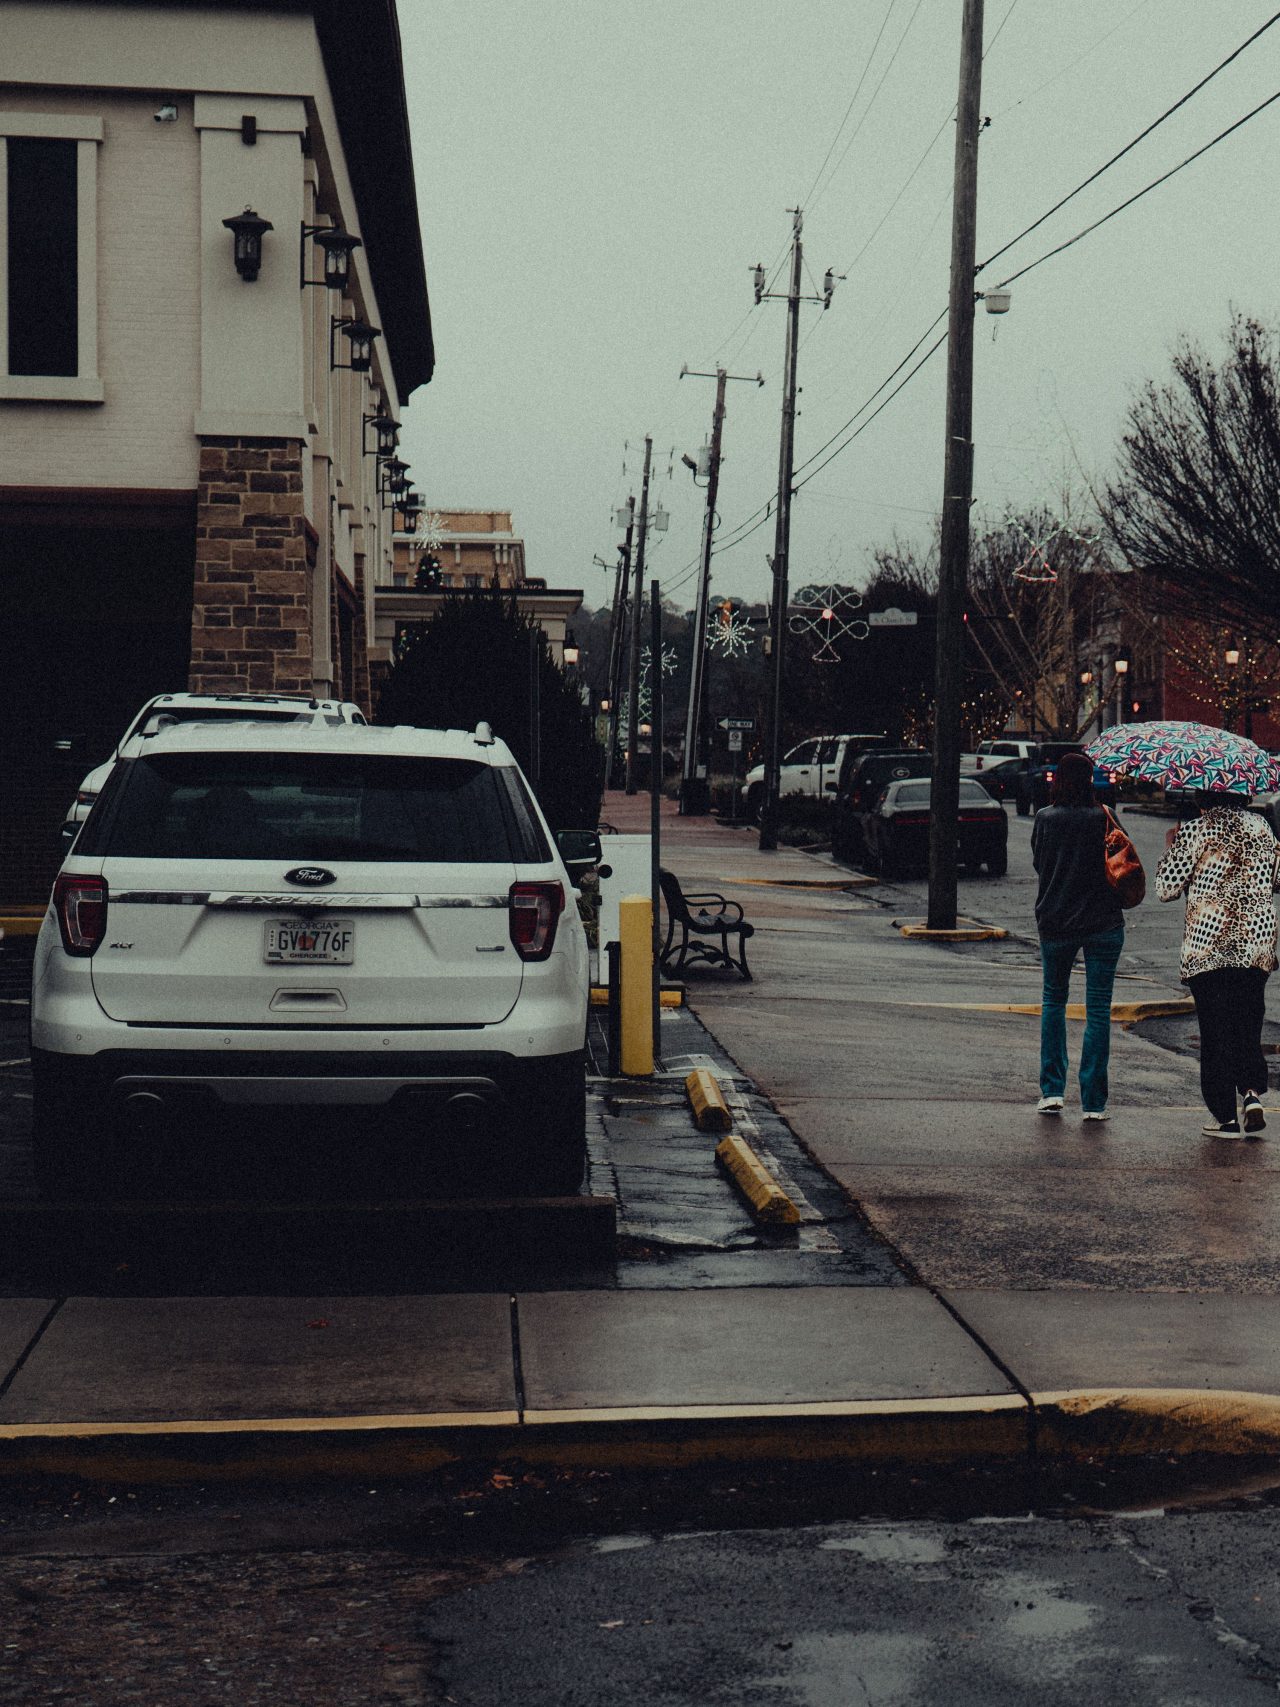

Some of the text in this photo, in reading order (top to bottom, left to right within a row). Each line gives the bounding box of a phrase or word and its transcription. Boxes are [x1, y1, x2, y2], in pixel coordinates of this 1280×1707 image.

[296, 869, 325, 881] Ford
[238, 896, 383, 905] EXPLORER
[284, 921, 334, 930] GEORGIA
